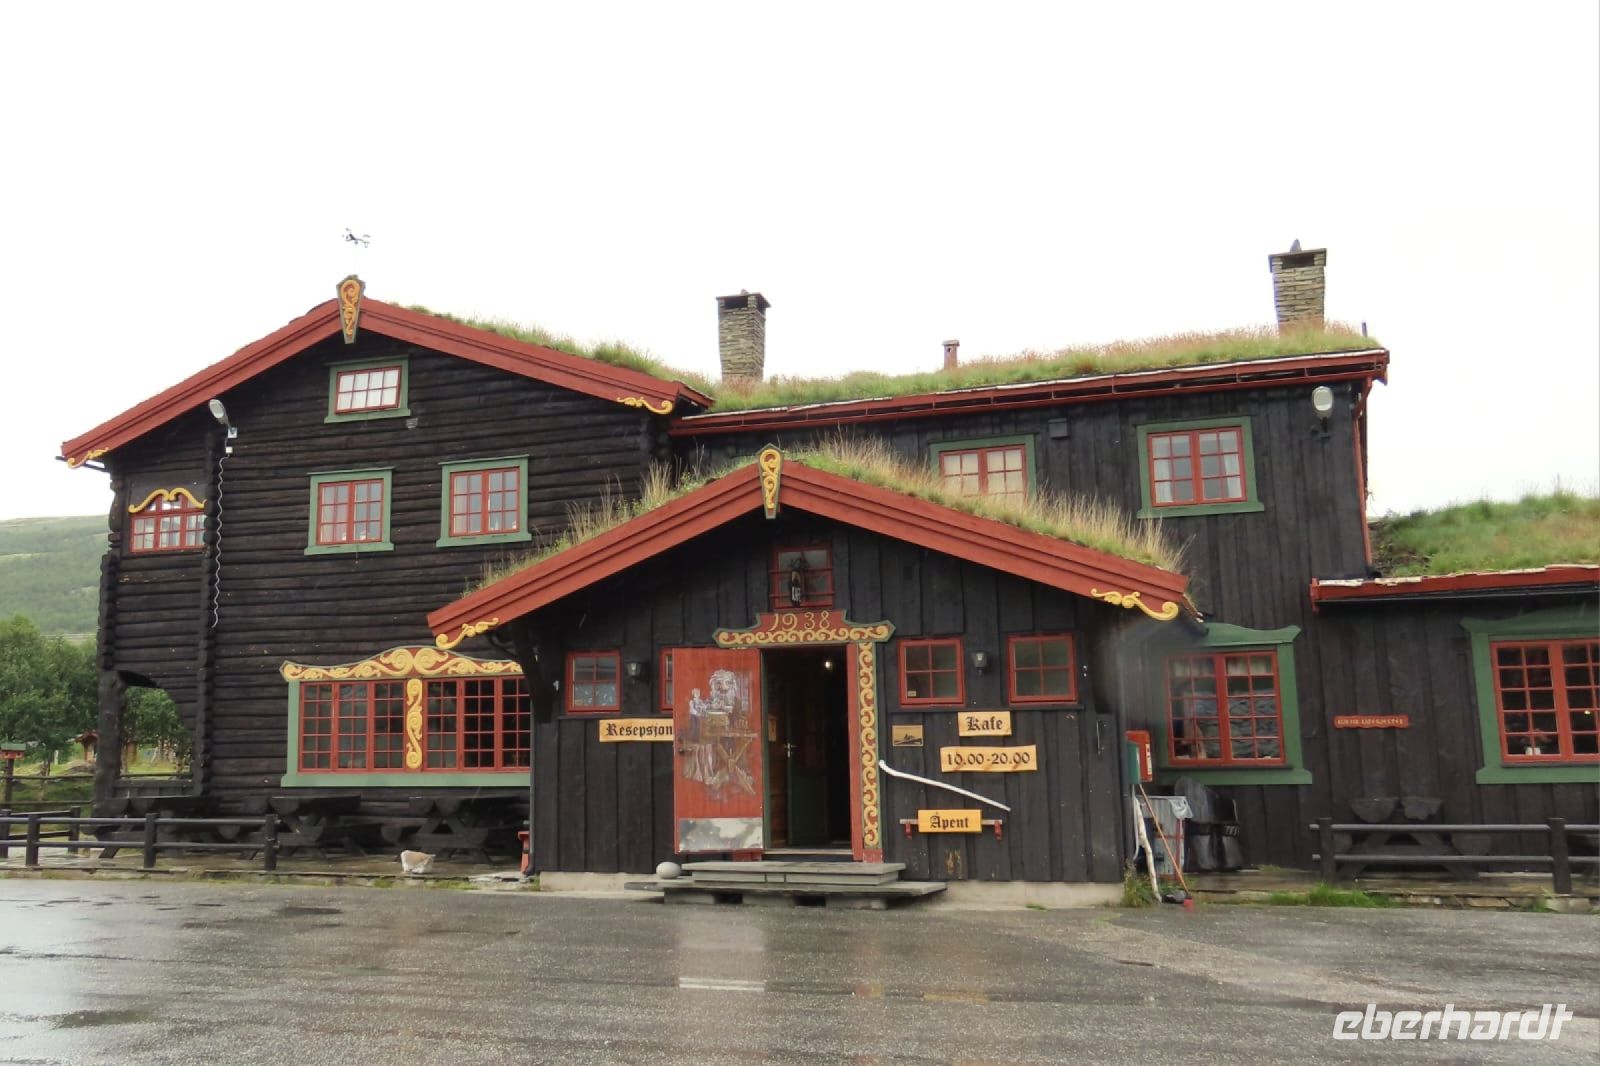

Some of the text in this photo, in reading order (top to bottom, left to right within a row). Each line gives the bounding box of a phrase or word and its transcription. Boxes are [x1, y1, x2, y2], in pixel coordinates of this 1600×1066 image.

[770, 611, 831, 631] 1938
[605, 723, 673, 738] Resepsjon
[966, 716, 1003, 731] Kafe
